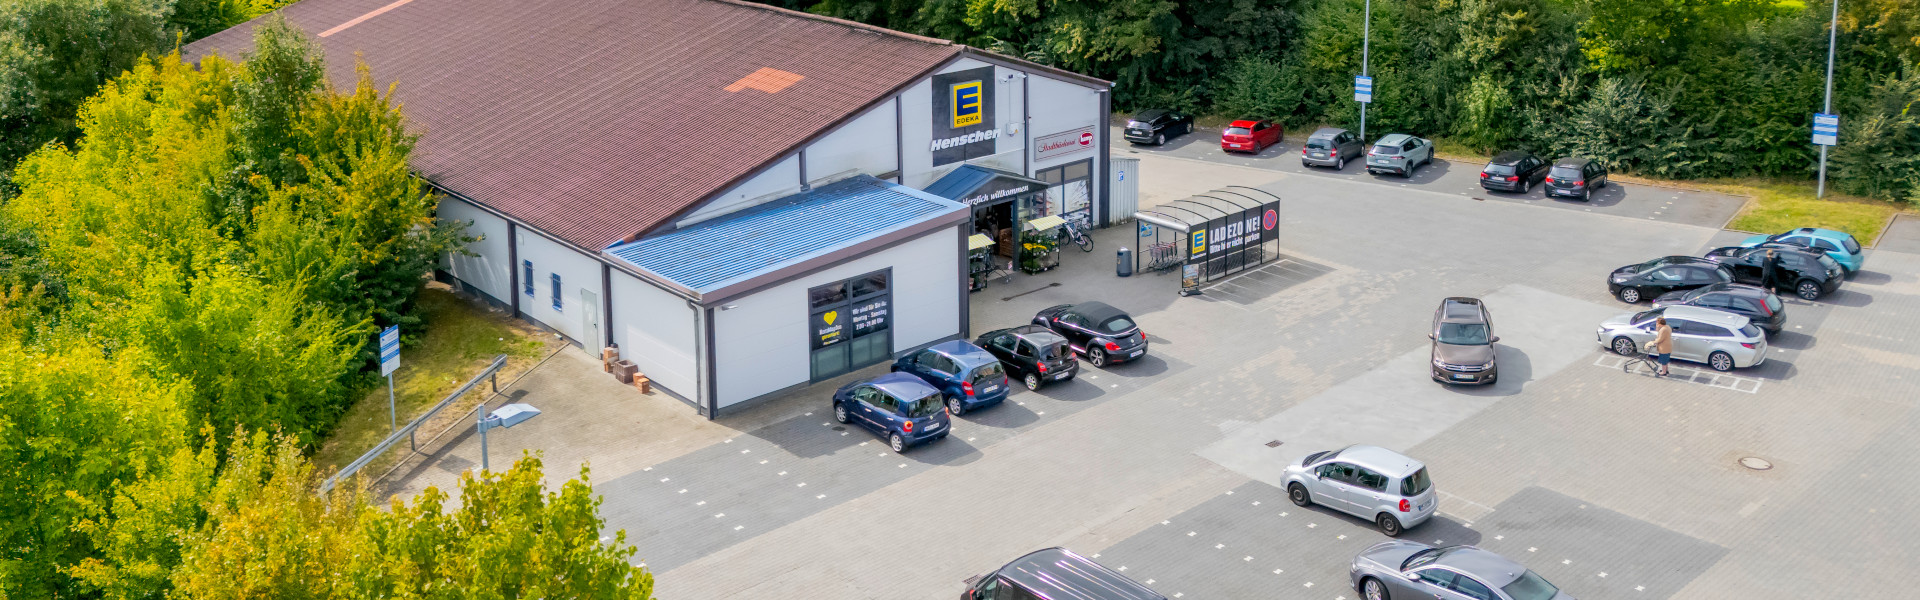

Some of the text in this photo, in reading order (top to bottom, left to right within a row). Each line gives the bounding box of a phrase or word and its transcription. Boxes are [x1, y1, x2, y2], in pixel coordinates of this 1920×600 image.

[956, 115, 979, 125] EDEKA
[930, 128, 1002, 152] Henschen
[962, 185, 1029, 206] Herzlich willkommen
[1232, 237, 1243, 248] nicht
[1245, 232, 1260, 245] parken
